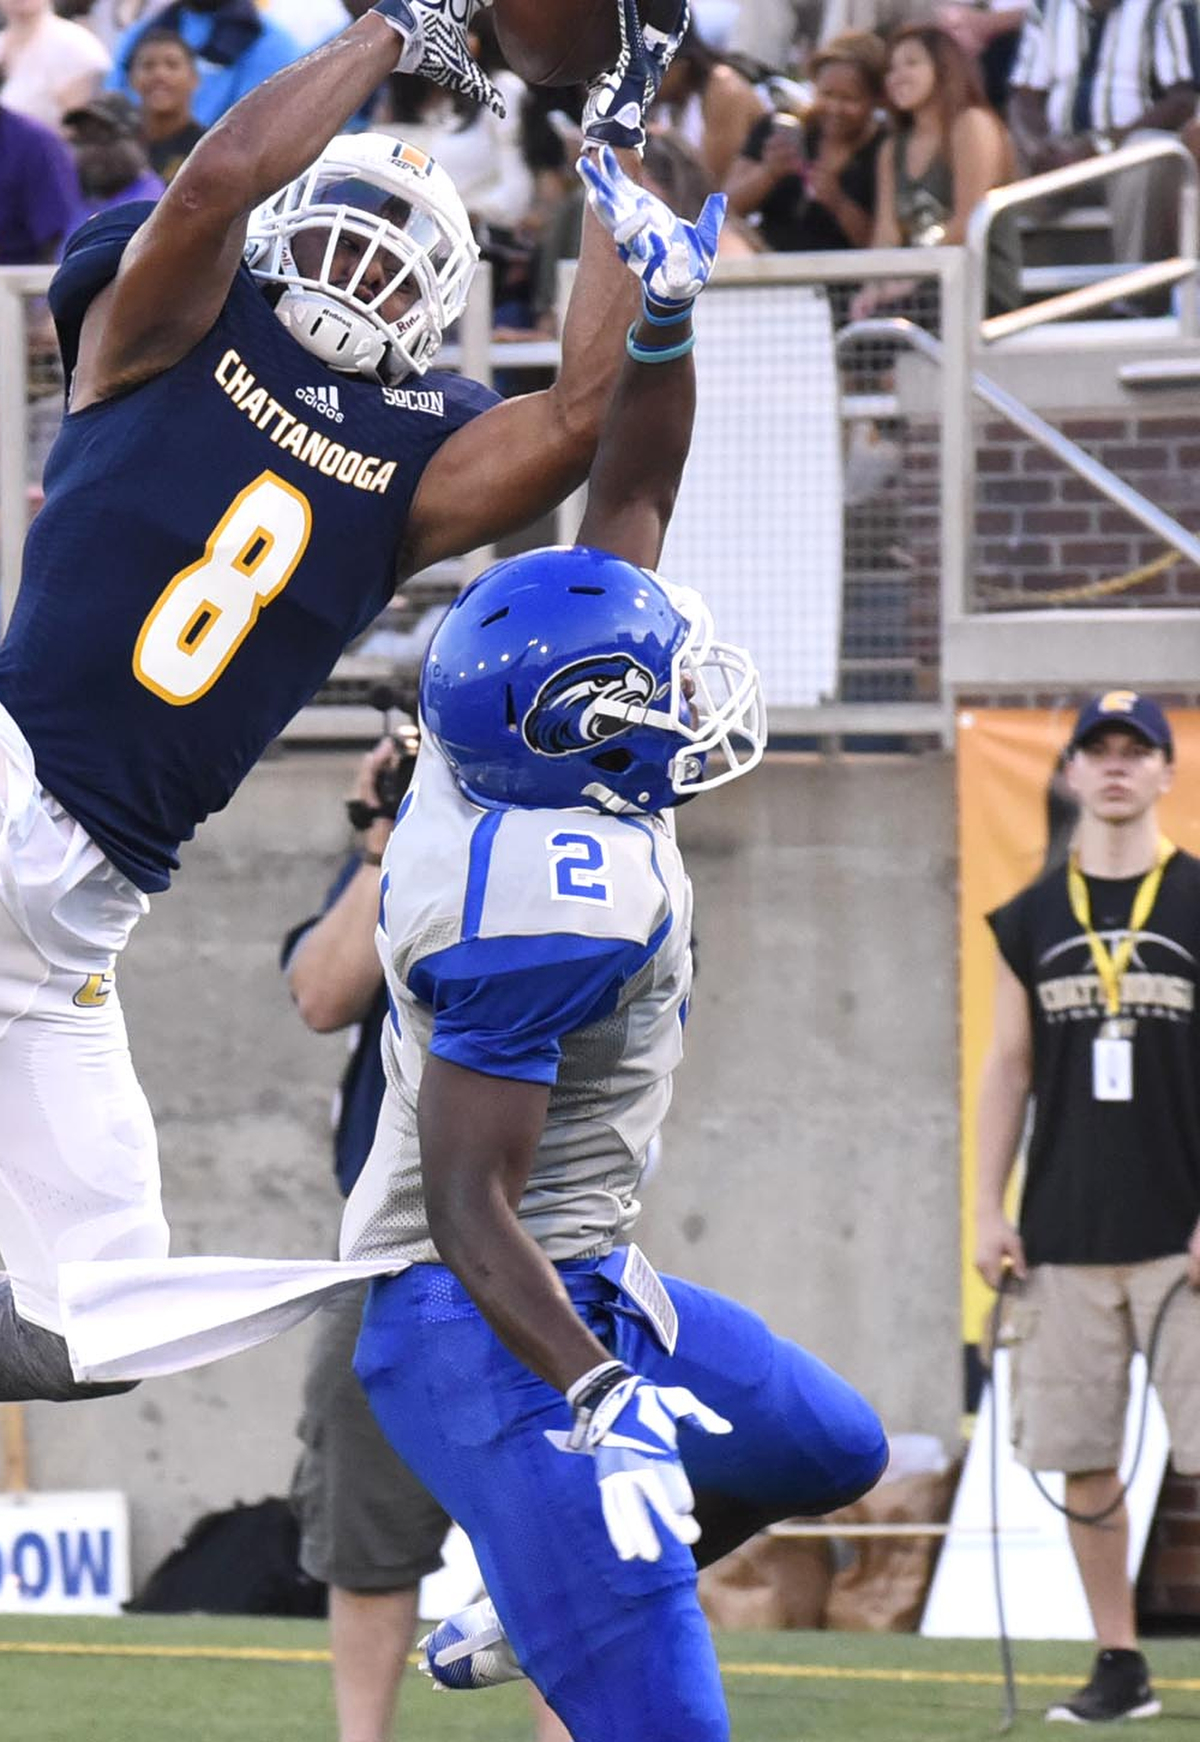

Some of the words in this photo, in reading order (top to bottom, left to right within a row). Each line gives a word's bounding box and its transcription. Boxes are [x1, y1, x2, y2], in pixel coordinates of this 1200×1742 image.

[214, 349, 397, 494] CHATTANOOGA
[295, 388, 344, 423] adidas
[133, 469, 313, 706] 8
[545, 828, 614, 908] 2
